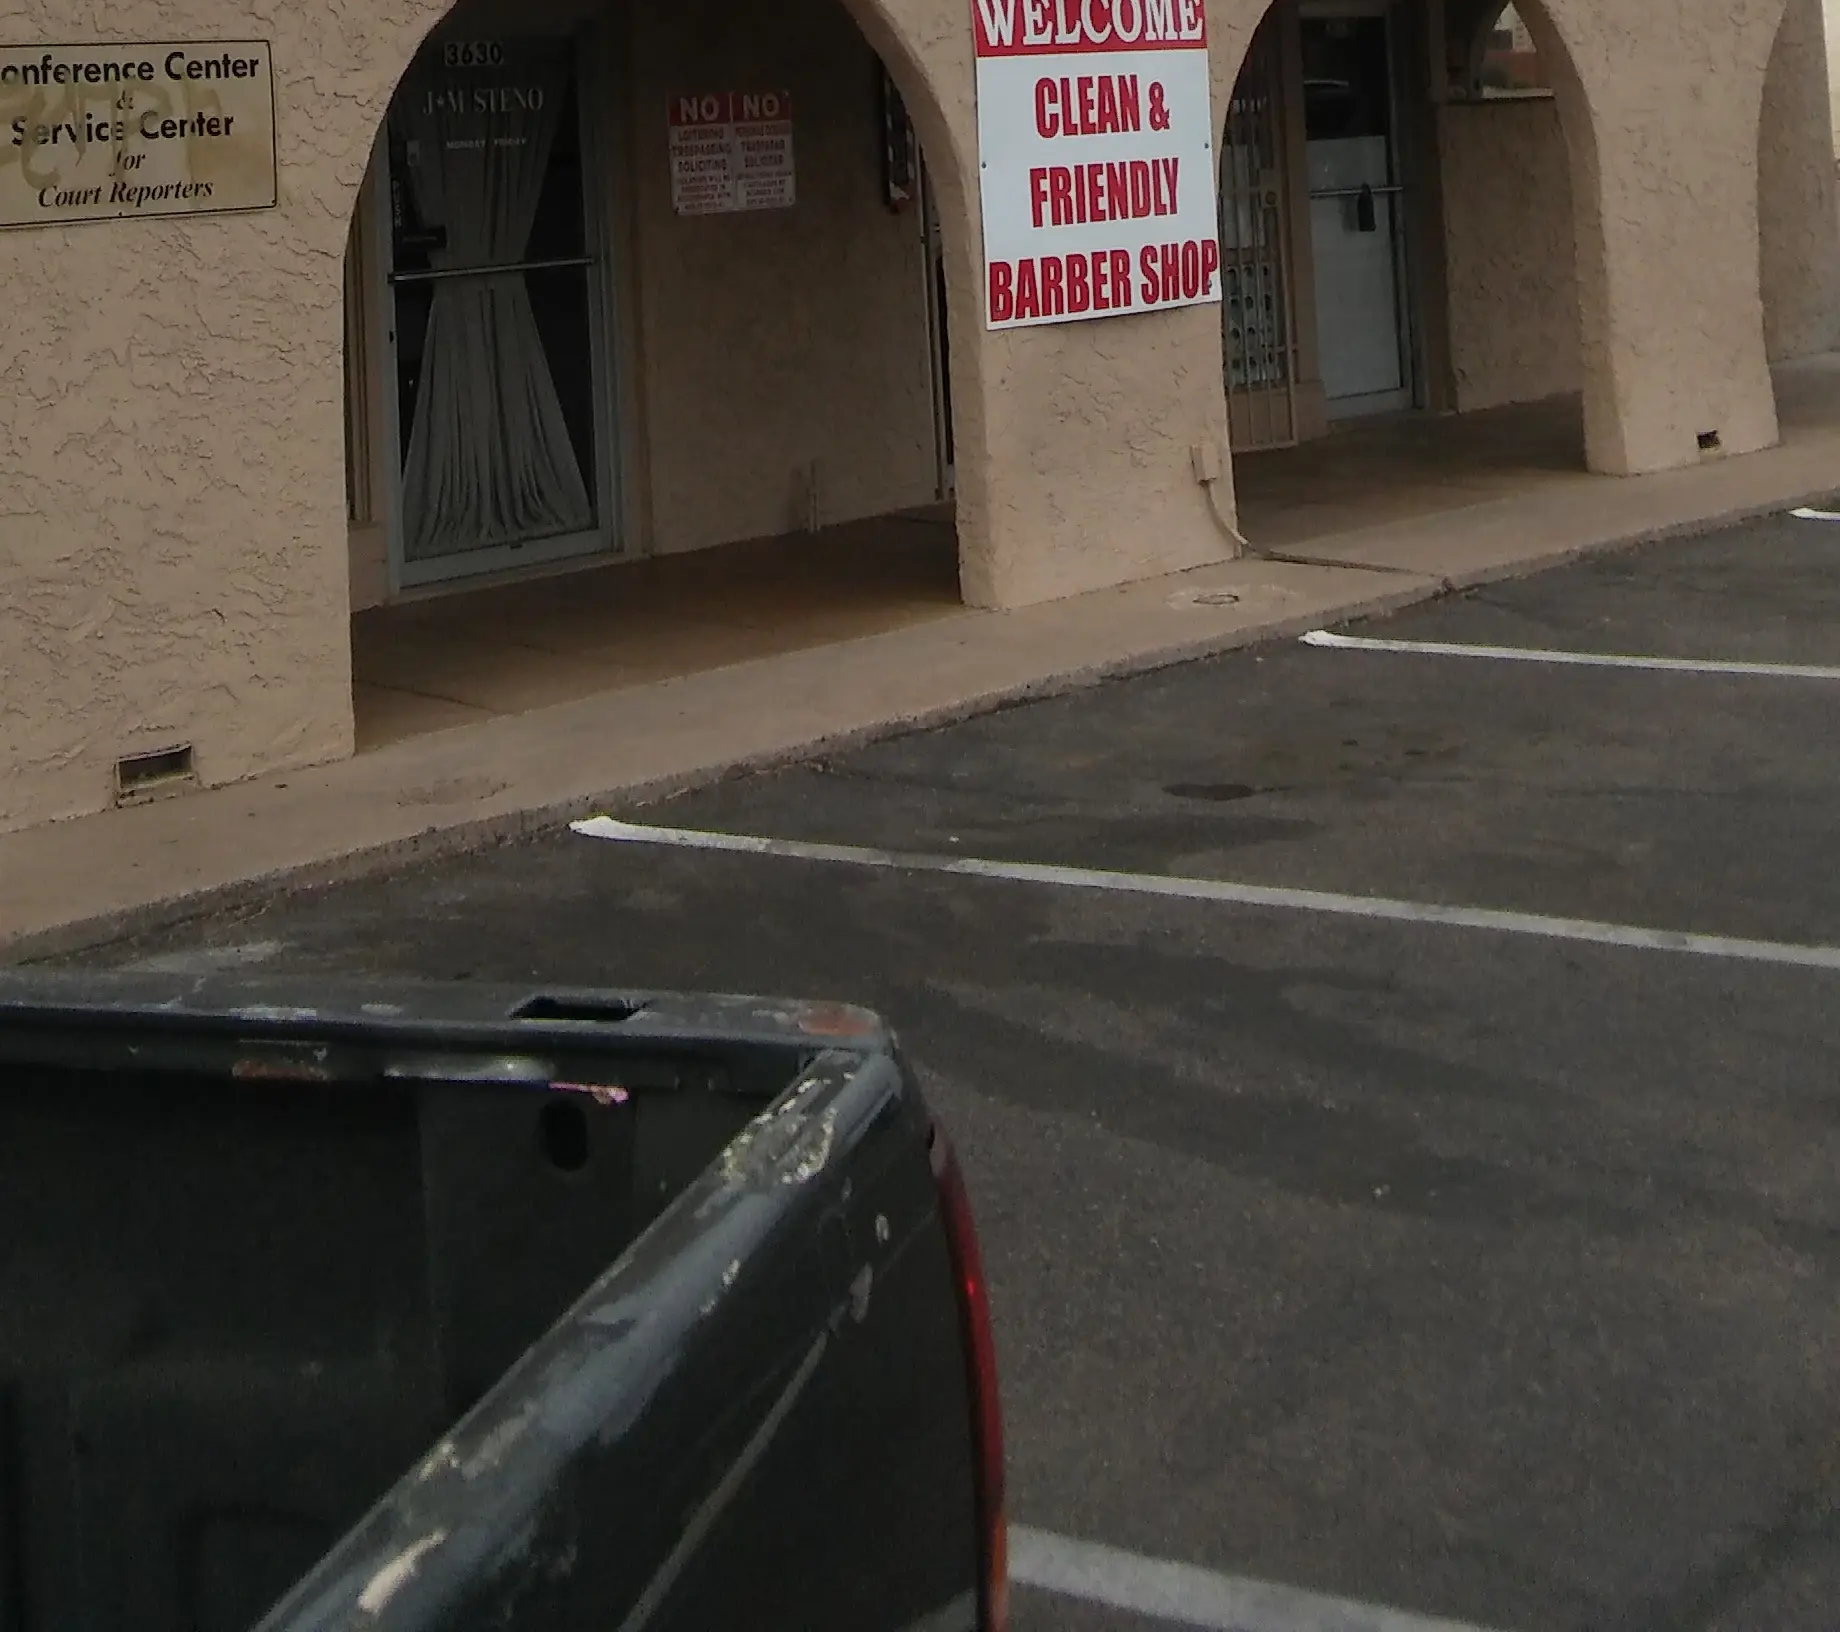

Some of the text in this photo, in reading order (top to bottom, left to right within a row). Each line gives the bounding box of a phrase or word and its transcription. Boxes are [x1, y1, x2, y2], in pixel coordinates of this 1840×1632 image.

[165, 51, 259, 81] Center
[447, 43, 502, 65] 3630
[473, 88, 544, 113] STENO
[680, 96, 720, 122] NO
[743, 93, 780, 119] NO
[1034, 74, 1170, 139] CLEAN &
[140, 111, 234, 141] Center
[38, 179, 214, 208] Court Reporters
[1029, 157, 1179, 228] FRIENDLY
[989, 239, 1218, 322] BARBER SHOP
